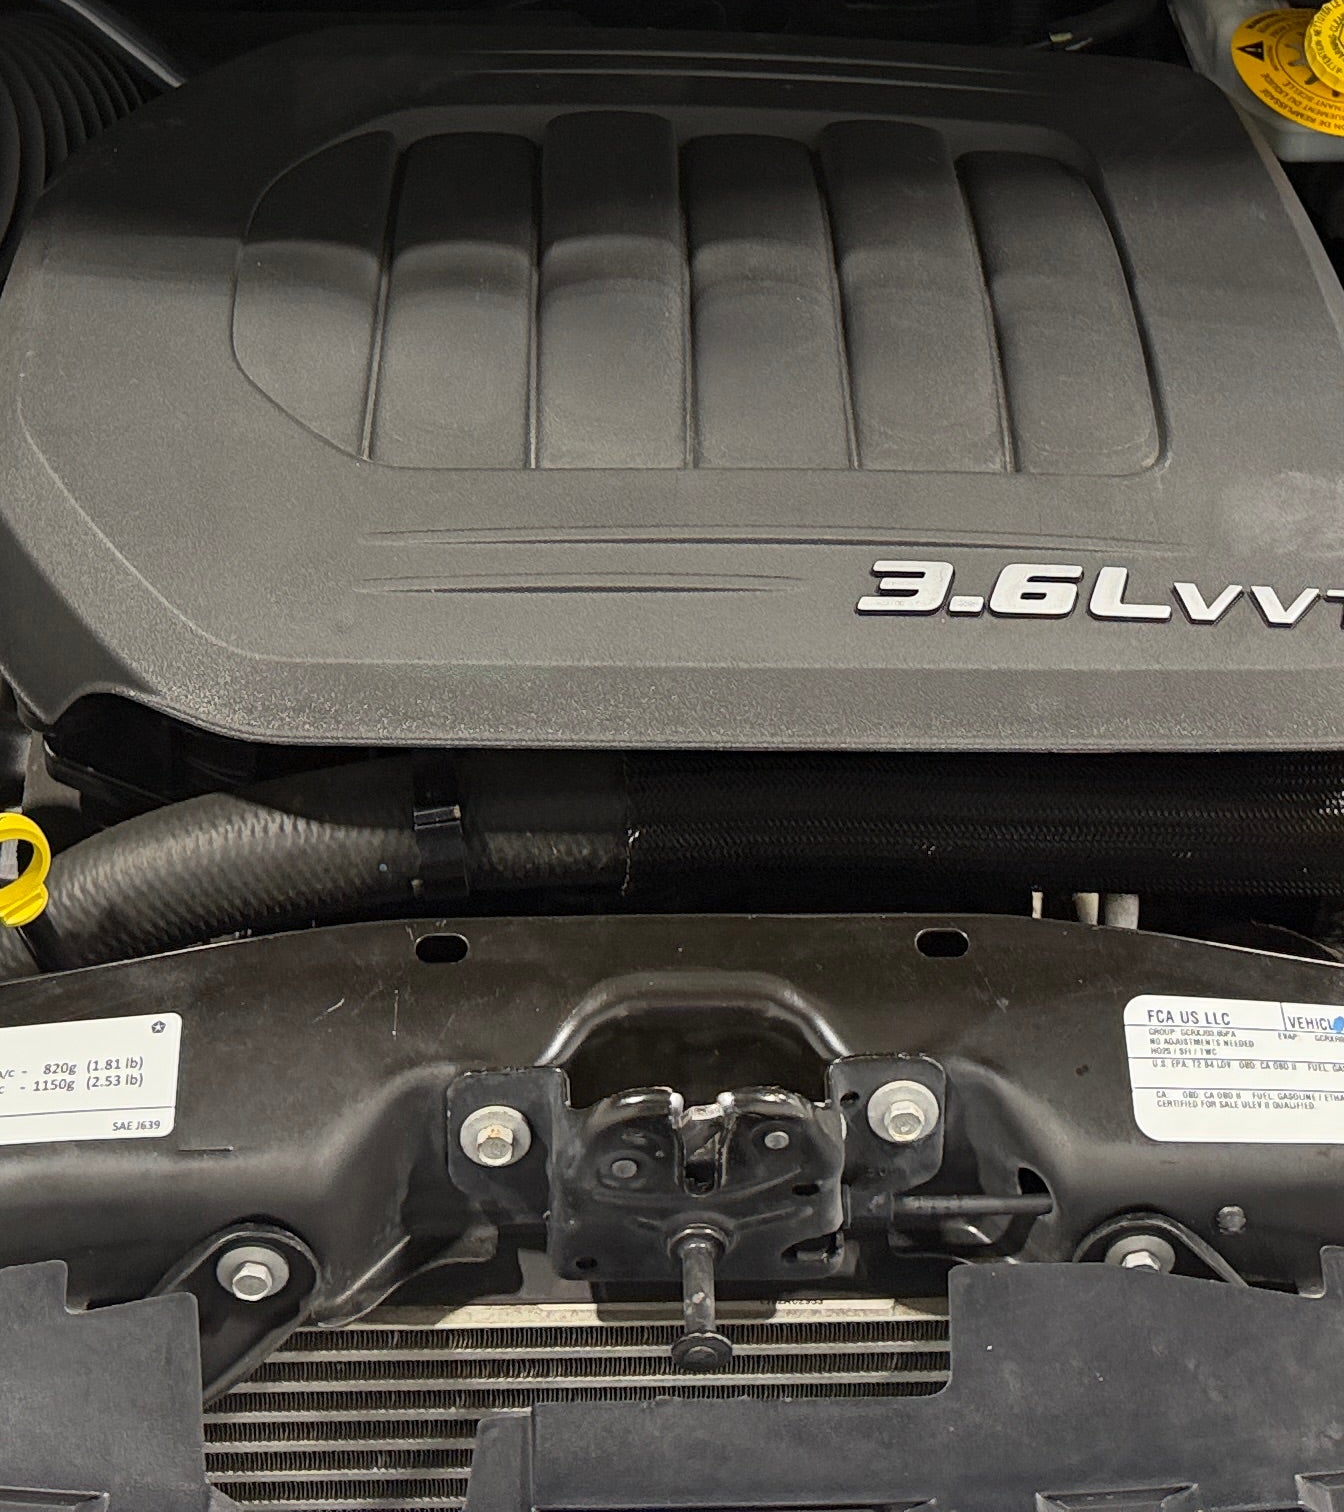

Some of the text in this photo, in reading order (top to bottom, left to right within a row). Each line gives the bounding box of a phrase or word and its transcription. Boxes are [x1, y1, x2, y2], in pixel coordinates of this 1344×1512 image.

[1147, 1009, 1232, 1026] FCA US LLC
[43, 1062, 78, 1076] 820g
[86, 1058, 122, 1075] (1.81
[125, 1055, 144, 1072] lb)
[33, 1078, 76, 1093] 1150g
[86, 1074, 122, 1091] (2.53
[125, 1072, 144, 1088] lb)
[112, 1119, 162, 1132] SAE J639
